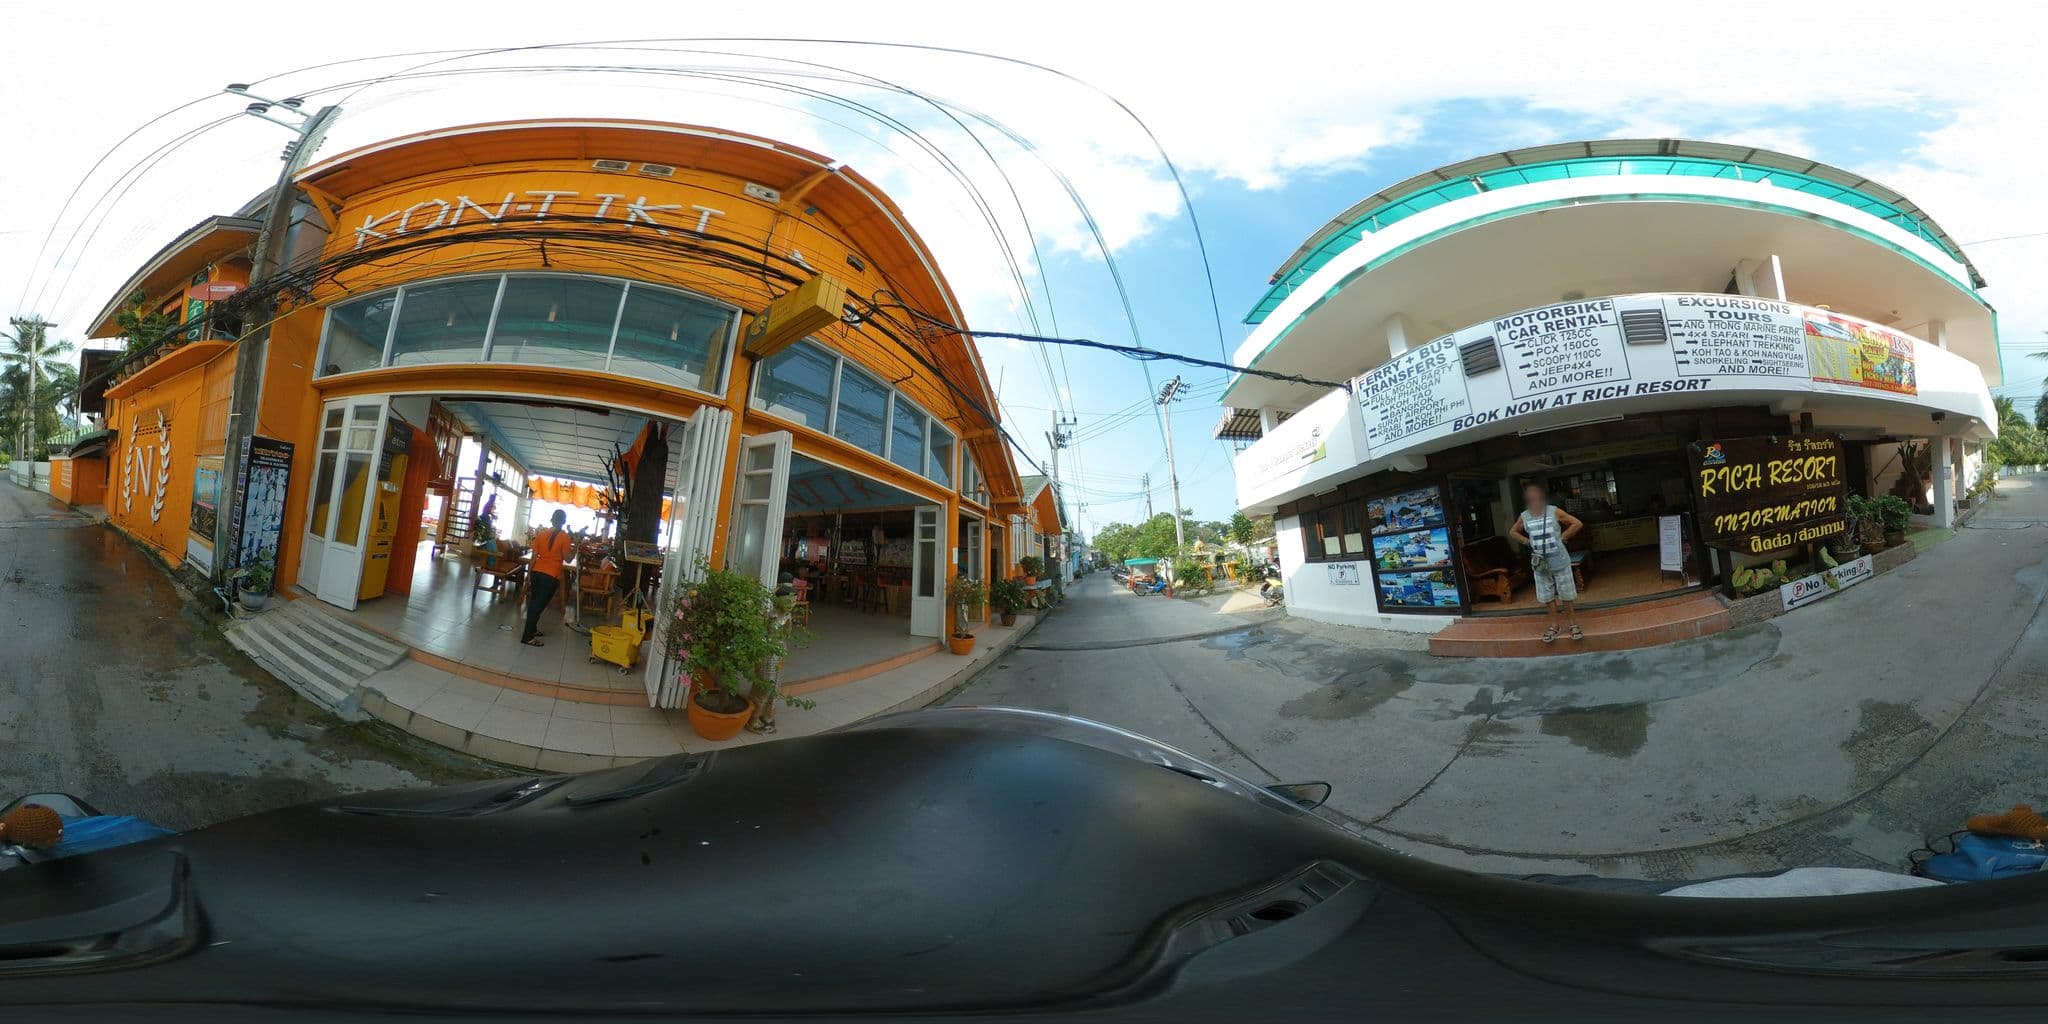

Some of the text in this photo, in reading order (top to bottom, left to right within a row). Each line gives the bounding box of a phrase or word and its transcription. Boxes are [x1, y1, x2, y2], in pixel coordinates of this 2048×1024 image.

[1496, 301, 1612, 331] MOTORBIKE
[1678, 297, 1790, 314] EXCURSIONS
[1704, 310, 1772, 323] TOURS
[1508, 313, 1608, 341] CAR RENTAL
[1683, 321, 1800, 336] ANG THONG MARINE PARK
[1710, 331, 1749, 339] SAFARI
[1527, 328, 1592, 349] CLICK 125CC
[1536, 338, 1599, 357] PCX 150CC
[1701, 339, 1795, 352] ELEPHANT TREKKING
[1764, 334, 1800, 344] FISHING
[1359, 360, 1401, 389] FERRY
[1420, 338, 1454, 359] BUS
[1533, 348, 1602, 369] SCOOPY 110CC
[1691, 349, 1712, 357] KOH
[1714, 349, 1731, 357] TAO
[1741, 349, 1760, 358] KOH
[1762, 350, 1804, 361] NANGYUAN
[1762, 359, 1804, 369] SIGHTSEEING
[1363, 353, 1446, 398] TRANSFERS
[1528, 367, 1613, 391] AND MORE!!
[1718, 366, 1789, 375] AND MORE!!
[1371, 364, 1453, 405] FULL MOON PARTY
[1380, 379, 1440, 408] KOH PHANGAN
[1390, 389, 1432, 411] KOH TAO
[1390, 396, 1434, 418] BANGKOK
[1415, 399, 1465, 422] KOH PHI PHI
[1453, 378, 1711, 432] BOOK NOW AT RICH RESORT
[1378, 398, 1446, 430] SURAT AIRPORT
[1378, 424, 1401, 437] KRABI
[1384, 414, 1442, 442] AND MORE!!
[1700, 455, 1837, 497] RICH RESORT
[1714, 495, 1837, 534] INFORMATION
[1805, 580, 1820, 592] No
